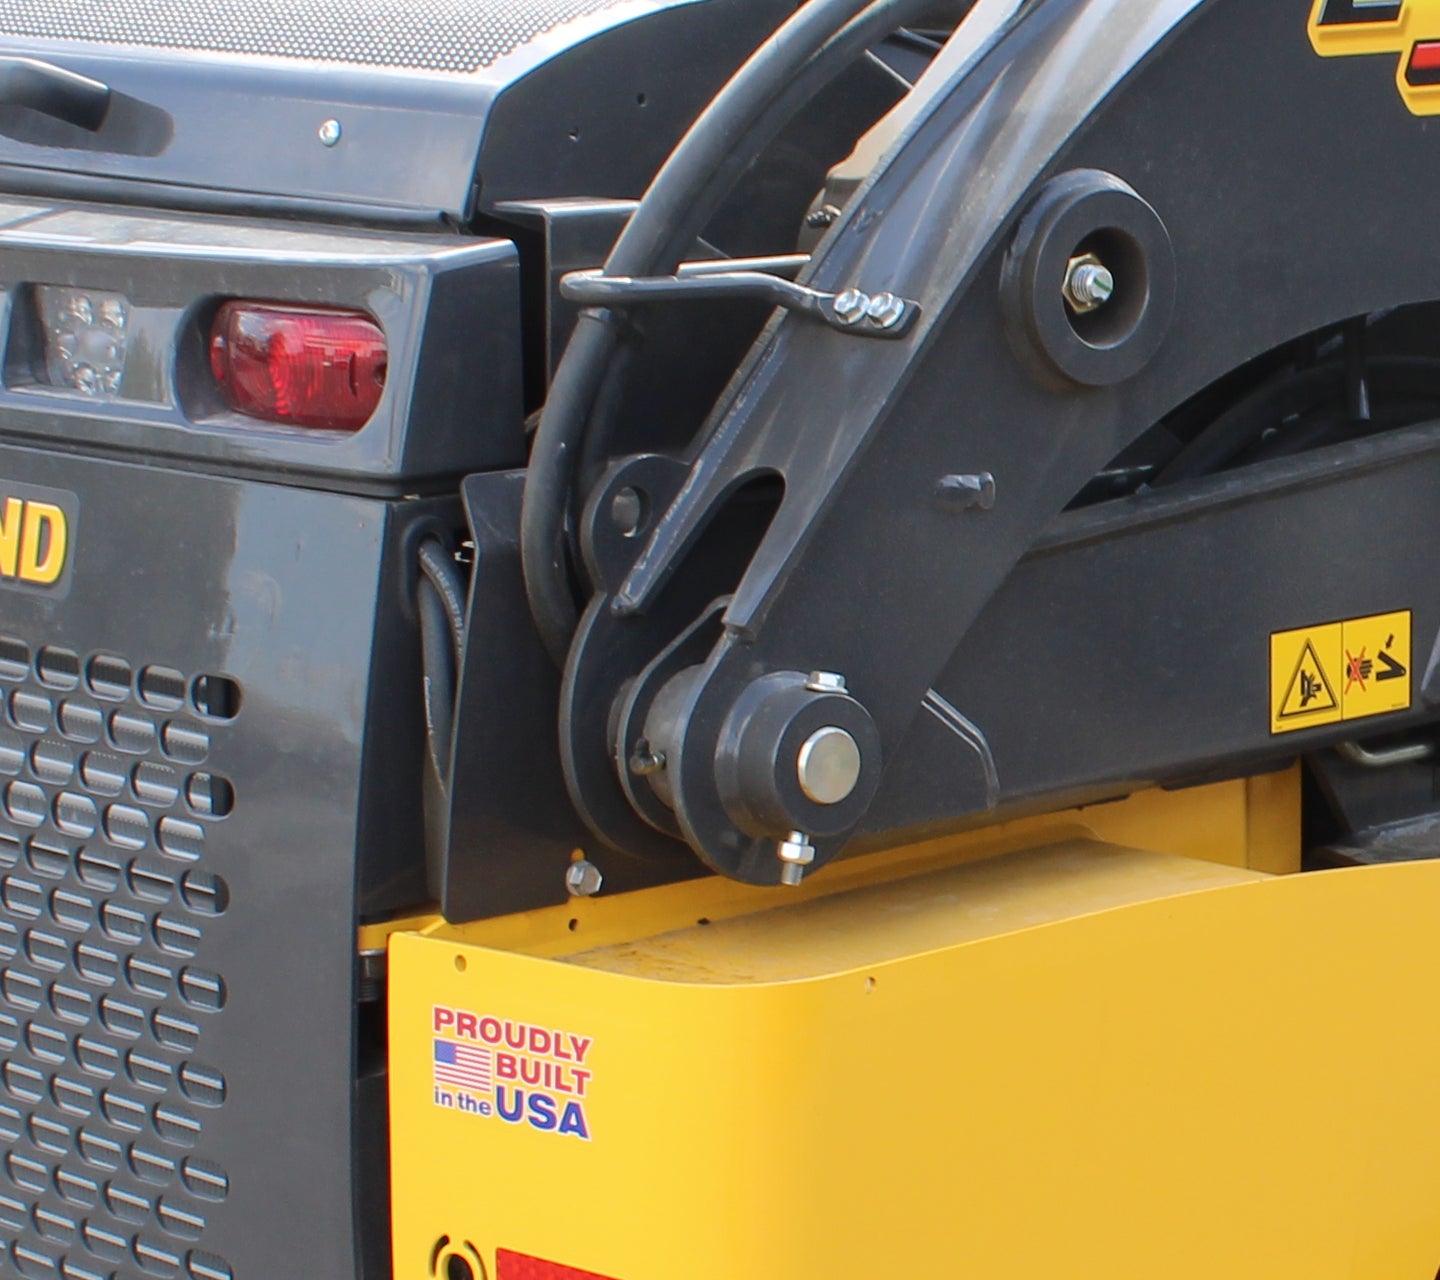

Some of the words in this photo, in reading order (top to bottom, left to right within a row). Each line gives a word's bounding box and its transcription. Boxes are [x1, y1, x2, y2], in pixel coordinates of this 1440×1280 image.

[433, 1006, 592, 1063] PROUDLY
[495, 1051, 592, 1096] BUILT
[433, 1086, 453, 1107] in
[457, 1092, 492, 1116] the
[495, 1084, 591, 1140] USA
